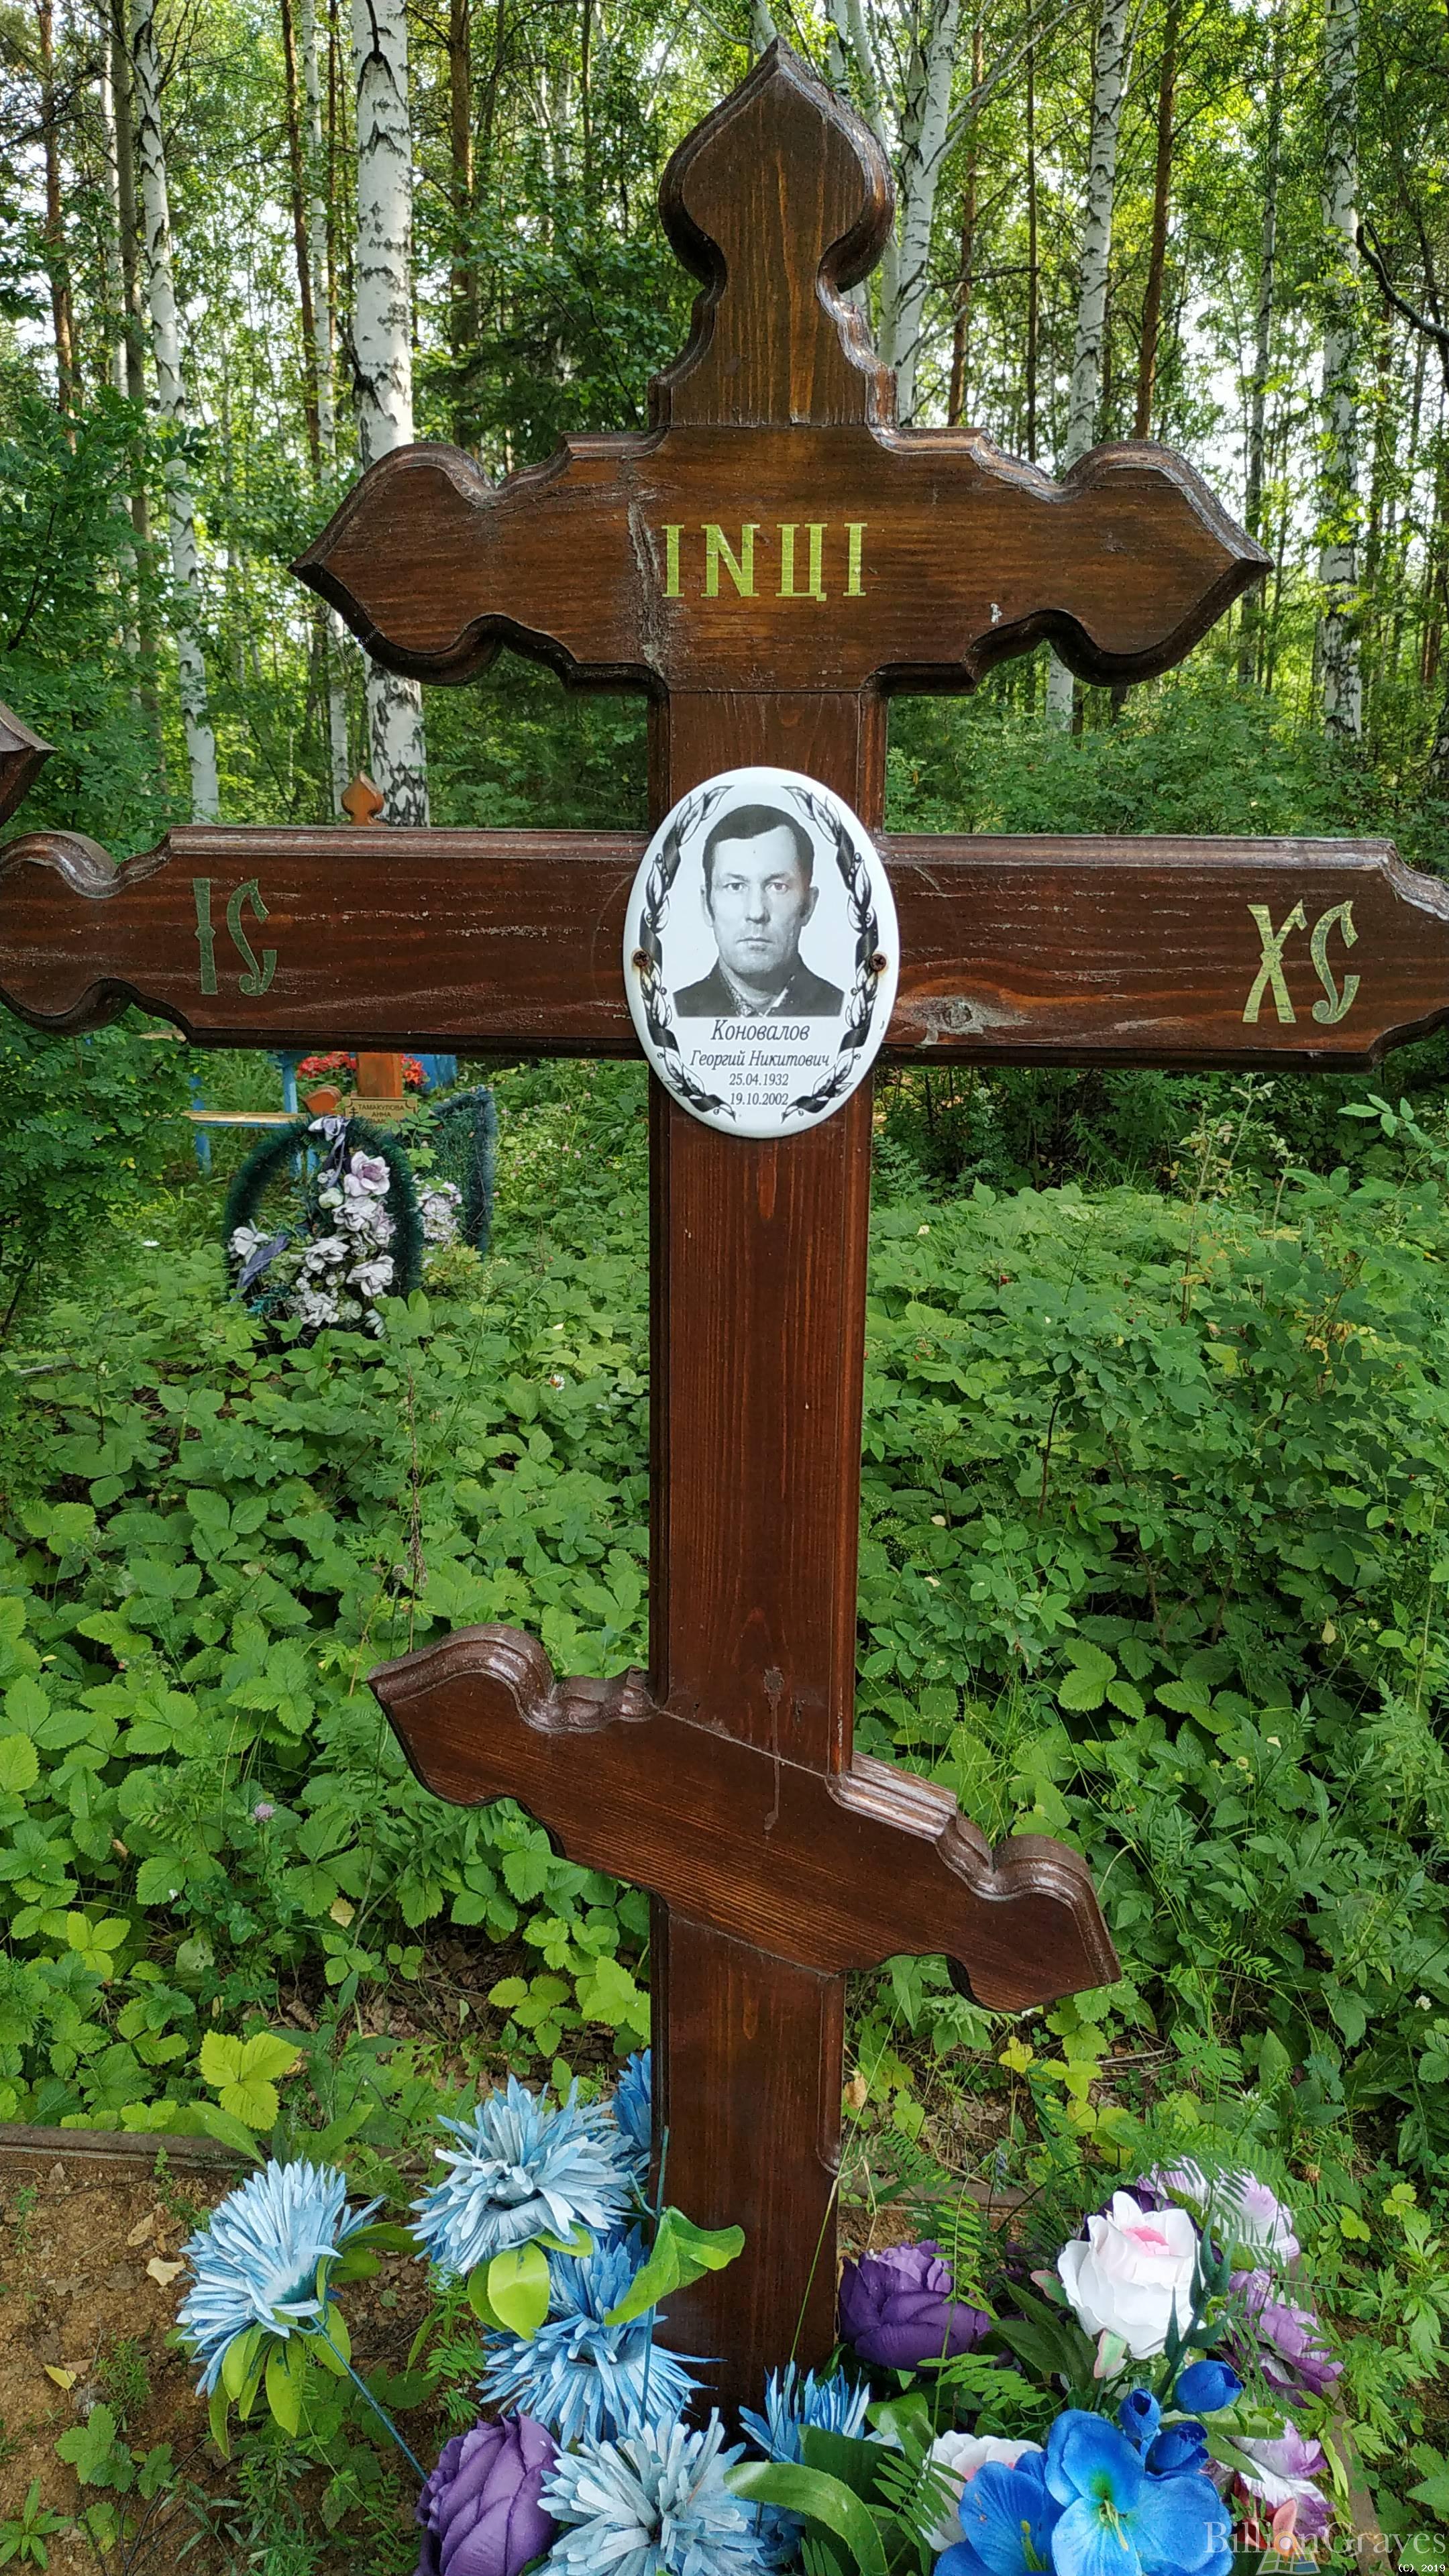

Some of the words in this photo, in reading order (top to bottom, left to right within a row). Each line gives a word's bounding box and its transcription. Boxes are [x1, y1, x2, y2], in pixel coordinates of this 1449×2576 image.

[710, 1019, 810, 1041] Коновалов
[689, 1050, 746, 1070] Георгий
[749, 1050, 830, 1067] Никитович
[729, 1073, 790, 1087] 25.04.1932
[730, 1092, 789, 1106] 19.10.2002
